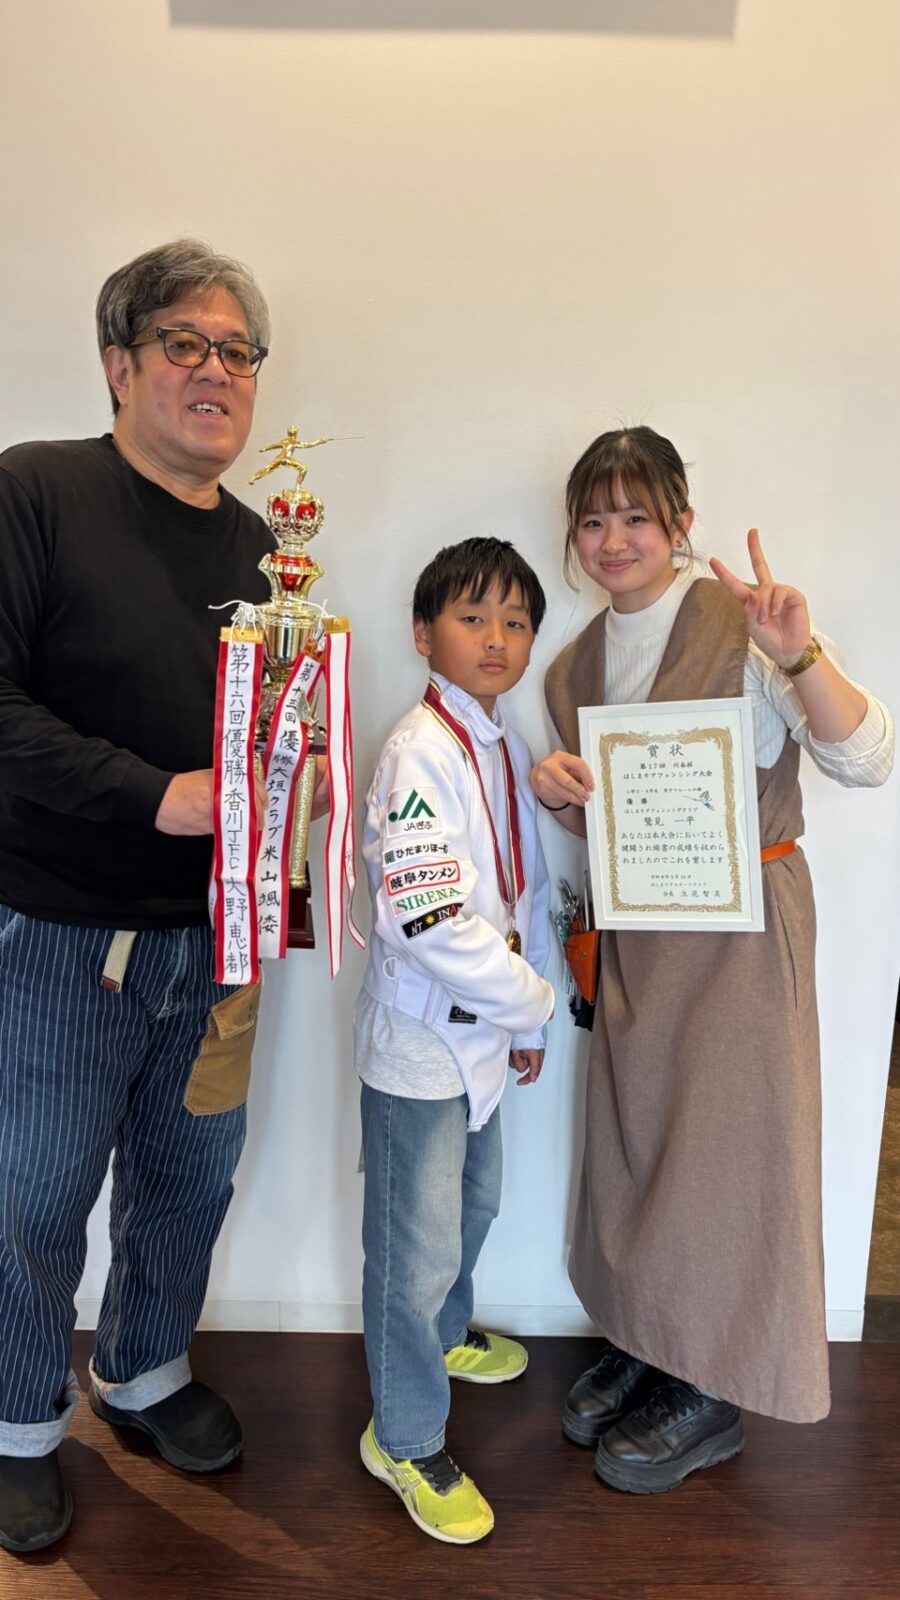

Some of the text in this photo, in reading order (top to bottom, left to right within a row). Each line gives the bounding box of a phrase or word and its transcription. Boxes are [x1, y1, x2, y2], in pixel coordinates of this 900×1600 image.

[403, 820, 433, 832] JAぎふ
[390, 866, 457, 891] 岐阜タンメン
[395, 886, 465, 913] SIRENA
